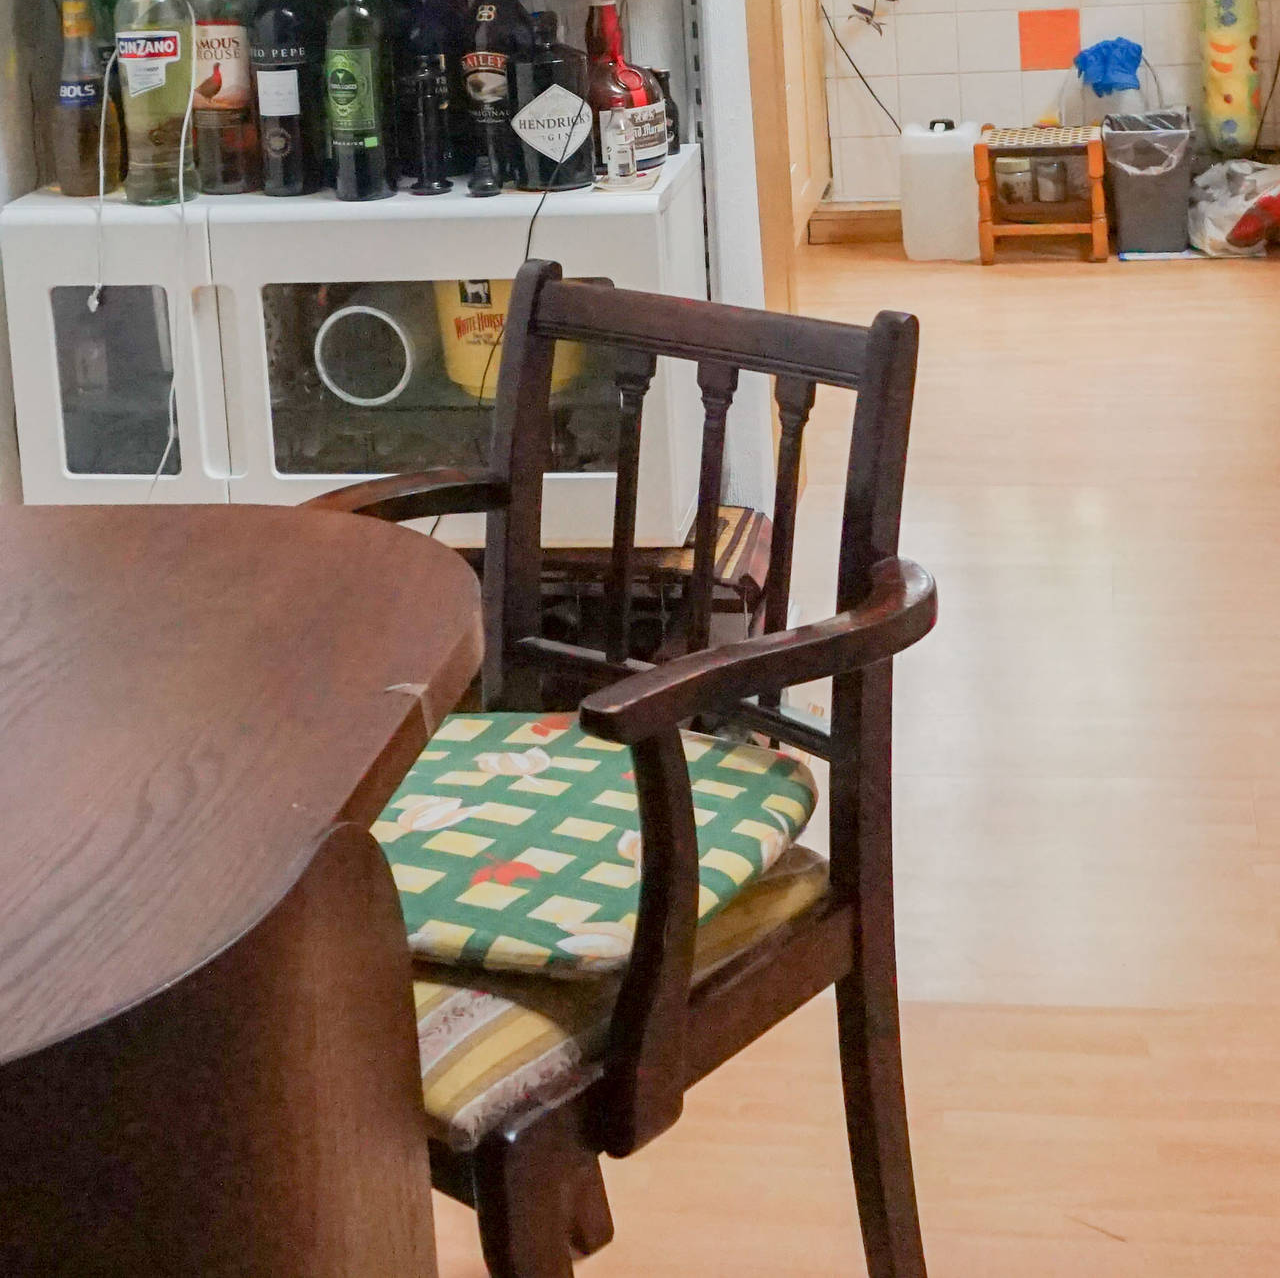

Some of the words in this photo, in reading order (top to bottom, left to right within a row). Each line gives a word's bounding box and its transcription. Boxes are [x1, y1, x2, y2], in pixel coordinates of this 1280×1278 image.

[118, 39, 175, 55] CINZANO
[271, 46, 305, 58] PEPE
[59, 84, 96, 98] BOLS
